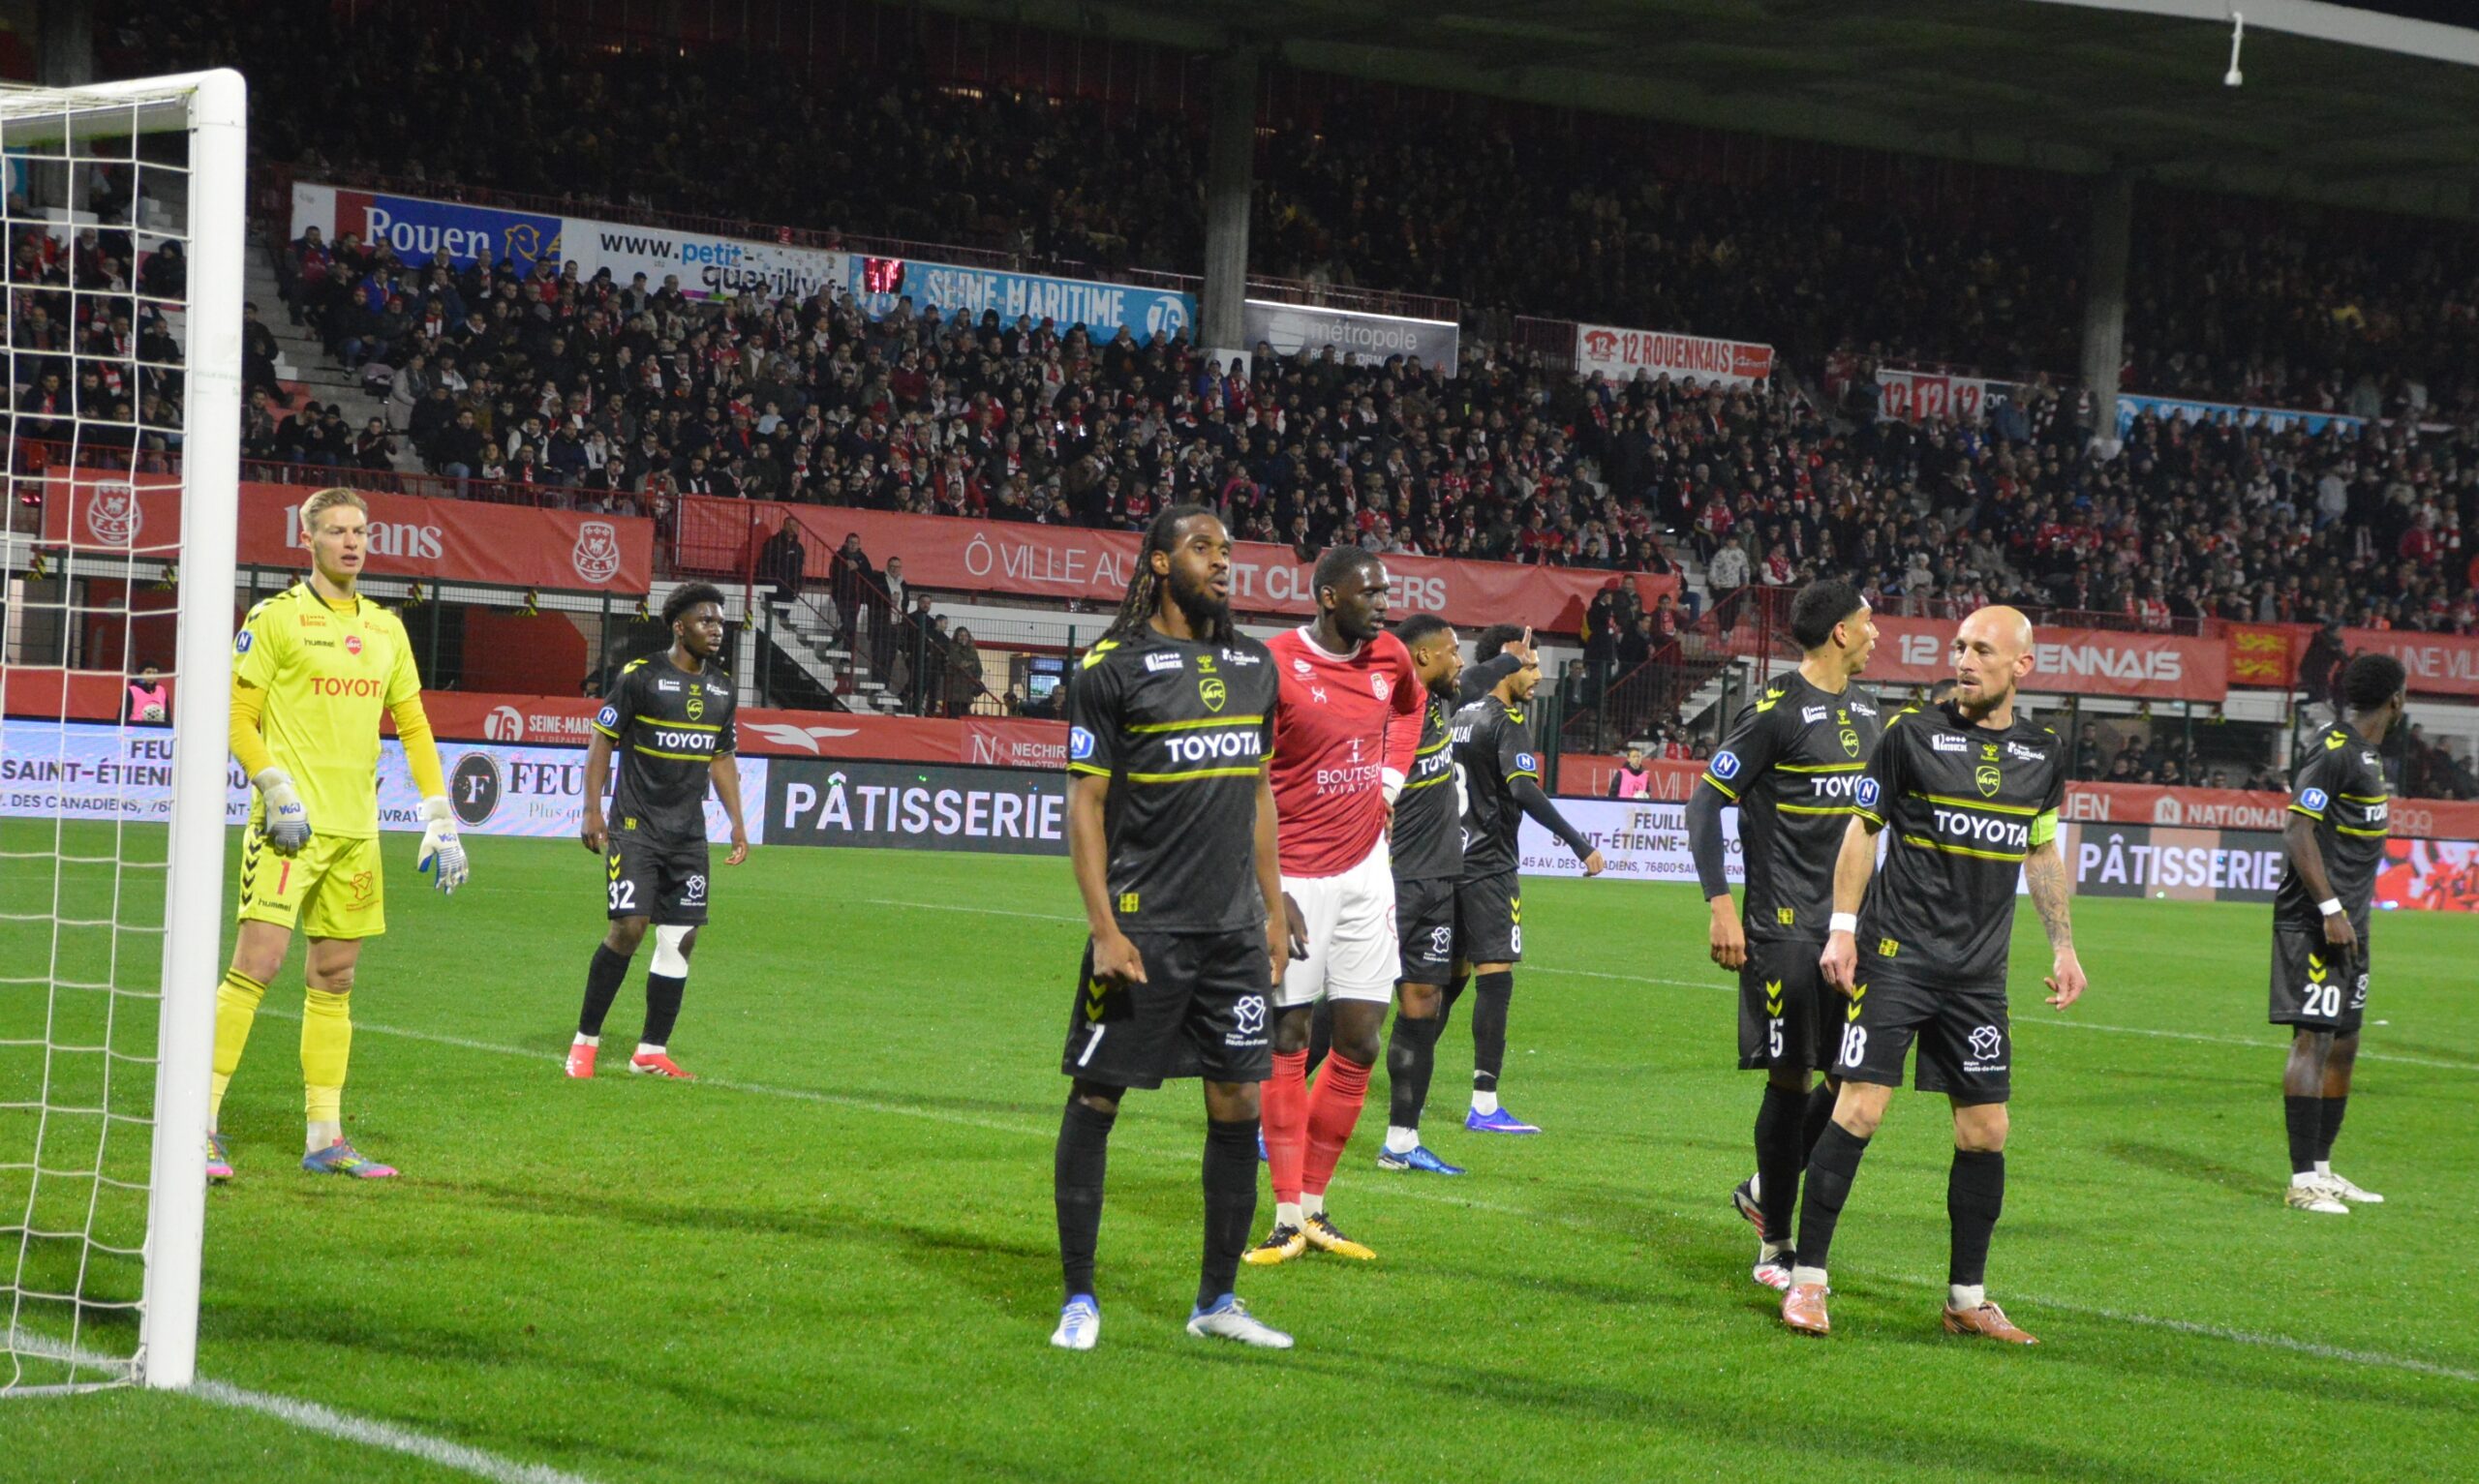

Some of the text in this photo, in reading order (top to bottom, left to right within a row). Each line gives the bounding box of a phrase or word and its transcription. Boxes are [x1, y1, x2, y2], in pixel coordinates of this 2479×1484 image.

[362, 206, 491, 259] Rouen
[1311, 318, 1418, 351] métropole
[1621, 332, 1637, 365] 12
[964, 531, 994, 577] Ô
[999, 542, 1087, 584] VILLE
[303, 637, 336, 648] hummel
[1898, 634, 1940, 666] 12
[310, 677, 383, 699] TOYOT
[529, 714, 595, 735] SEINE-MARI
[1011, 742, 1068, 759] NECHIR
[1164, 731, 1262, 763] TOYOTA
[1978, 775, 1999, 786] VAFC
[785, 771, 1063, 841] PÂTISSERIE
[1934, 809, 2028, 848] TOYOTA
[277, 860, 291, 896] 1
[1522, 857, 1536, 868] 45
[1537, 858, 1555, 869] AV.
[1557, 860, 1577, 870] DES
[1644, 862, 1676, 874] 76800
[2077, 833, 2283, 891] PÂTISSERIE
[258, 897, 292, 912] hummel
[608, 879, 635, 911] 32
[1511, 924, 1521, 954] 8
[2302, 983, 2341, 1018] 20
[1077, 1021, 1106, 1067] 7
[1769, 1017, 1784, 1058] 5
[1839, 1022, 1867, 1068] 18
